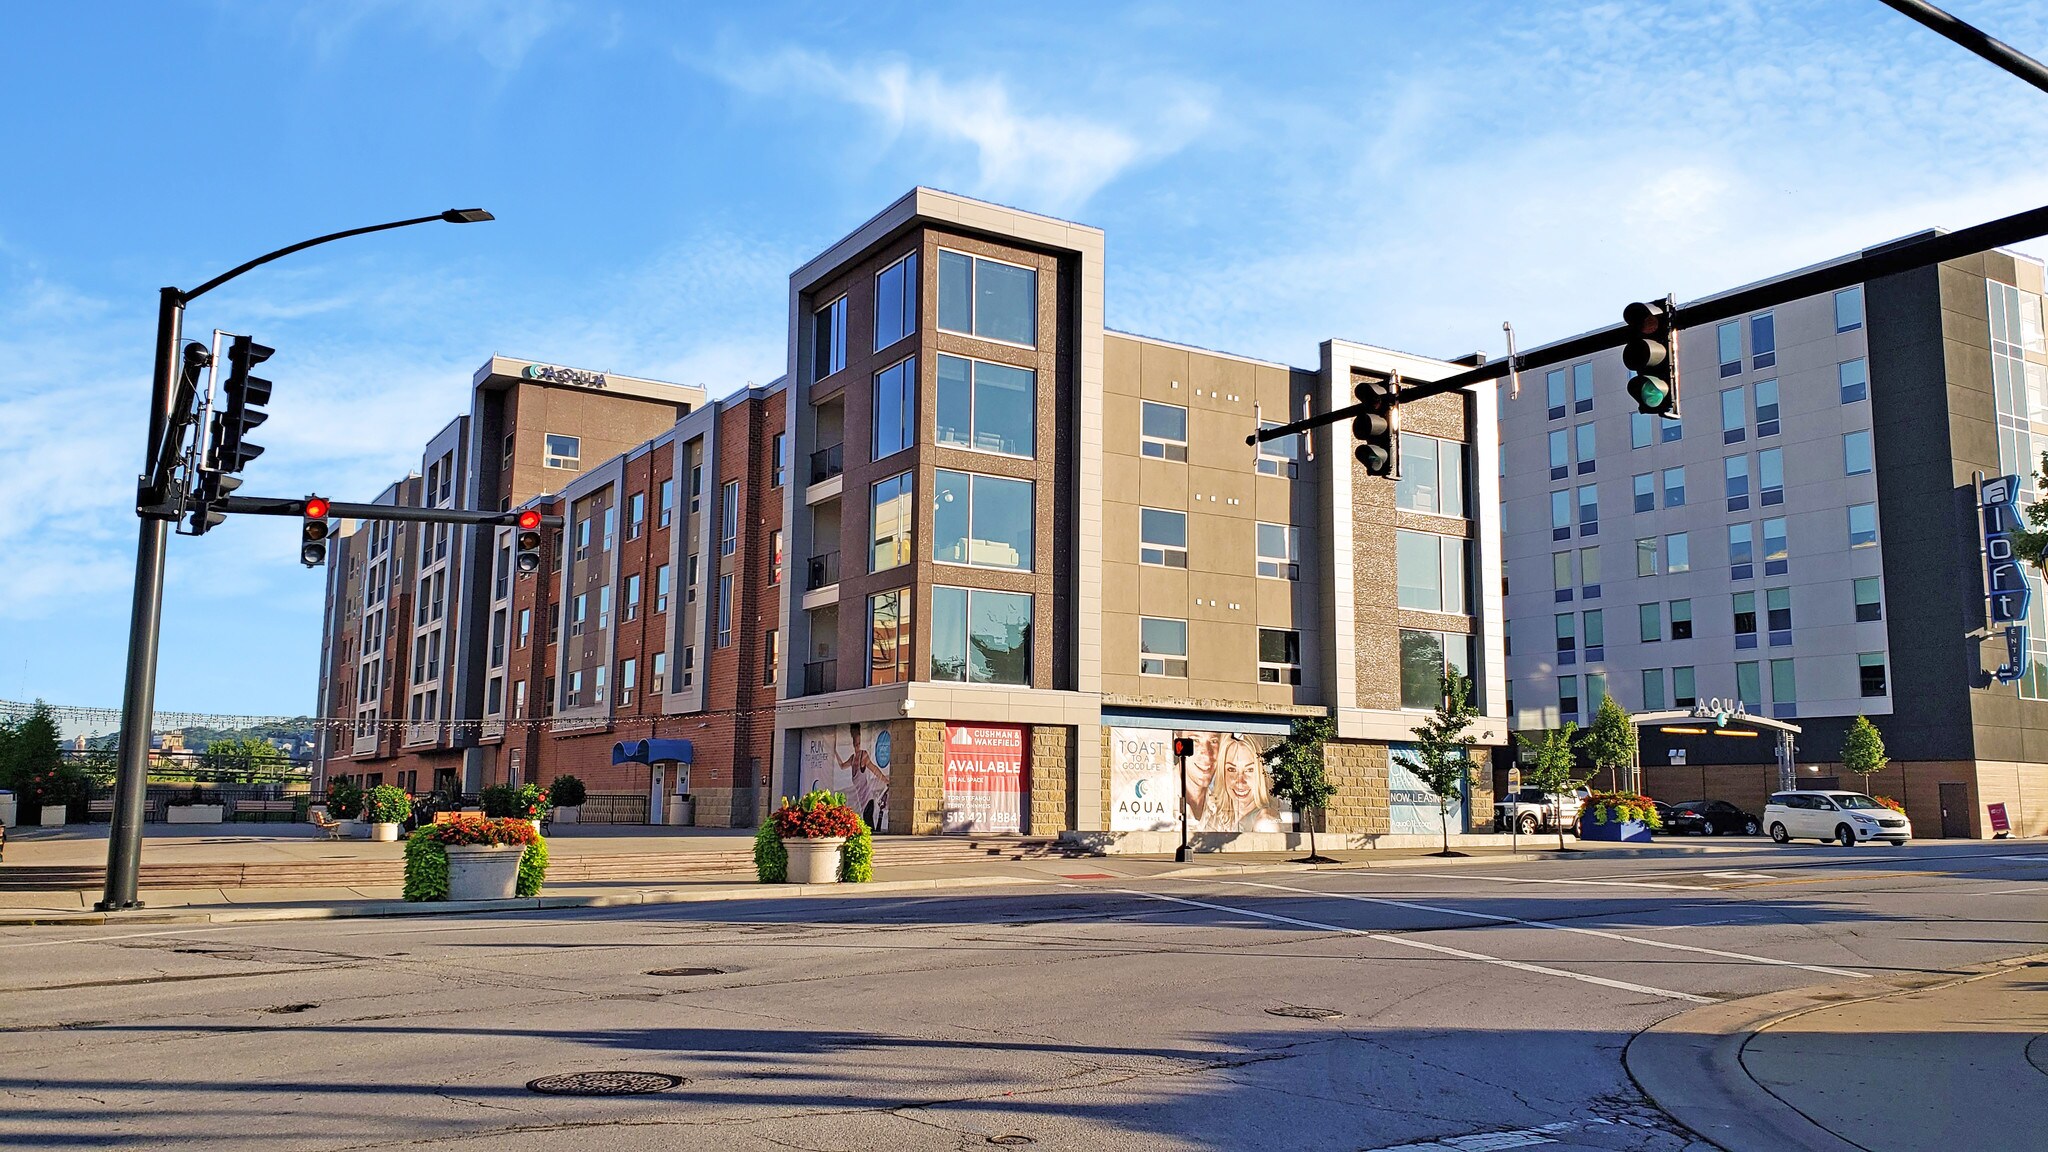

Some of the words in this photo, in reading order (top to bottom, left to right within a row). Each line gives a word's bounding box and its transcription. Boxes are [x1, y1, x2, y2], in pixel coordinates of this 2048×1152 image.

[2010, 629, 2019, 673] ENTER
[1697, 697, 1746, 715] AQUA
[974, 730, 1012, 738] CUSHMAN
[811, 740, 824, 753] RUN
[974, 738, 1020, 747] WAKEFIELD
[1119, 740, 1164, 755] TOAST
[948, 760, 1020, 774] AVAILABLE
[1122, 762, 1145, 770] GOOD
[1146, 763, 1161, 771] LIFE
[1390, 793, 1410, 802] NOW
[1412, 793, 1444, 803] LEASIN
[1119, 801, 1165, 815] AQUA
[947, 812, 965, 823] 513
[968, 812, 987, 823] 421
[990, 812, 1017, 823] 4884
